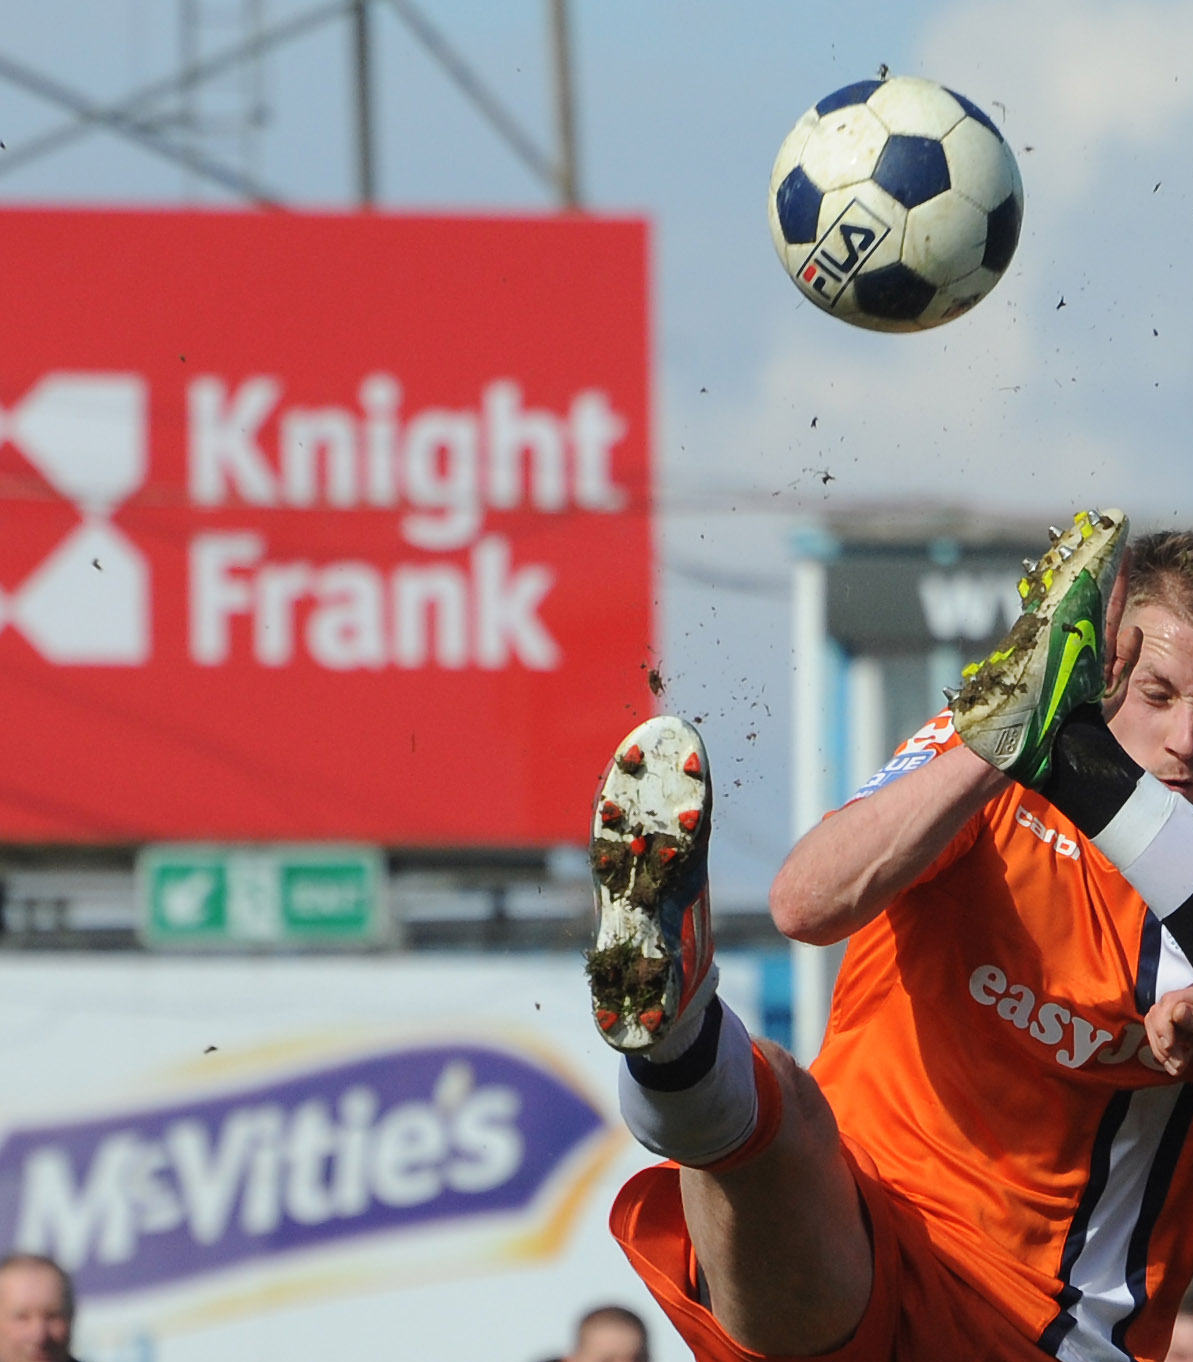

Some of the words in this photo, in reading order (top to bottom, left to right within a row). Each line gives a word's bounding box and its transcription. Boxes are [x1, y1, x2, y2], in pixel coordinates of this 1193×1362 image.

[802, 223, 876, 301] FILA
[186, 371, 628, 549] Knight
[187, 531, 560, 671] Frank
